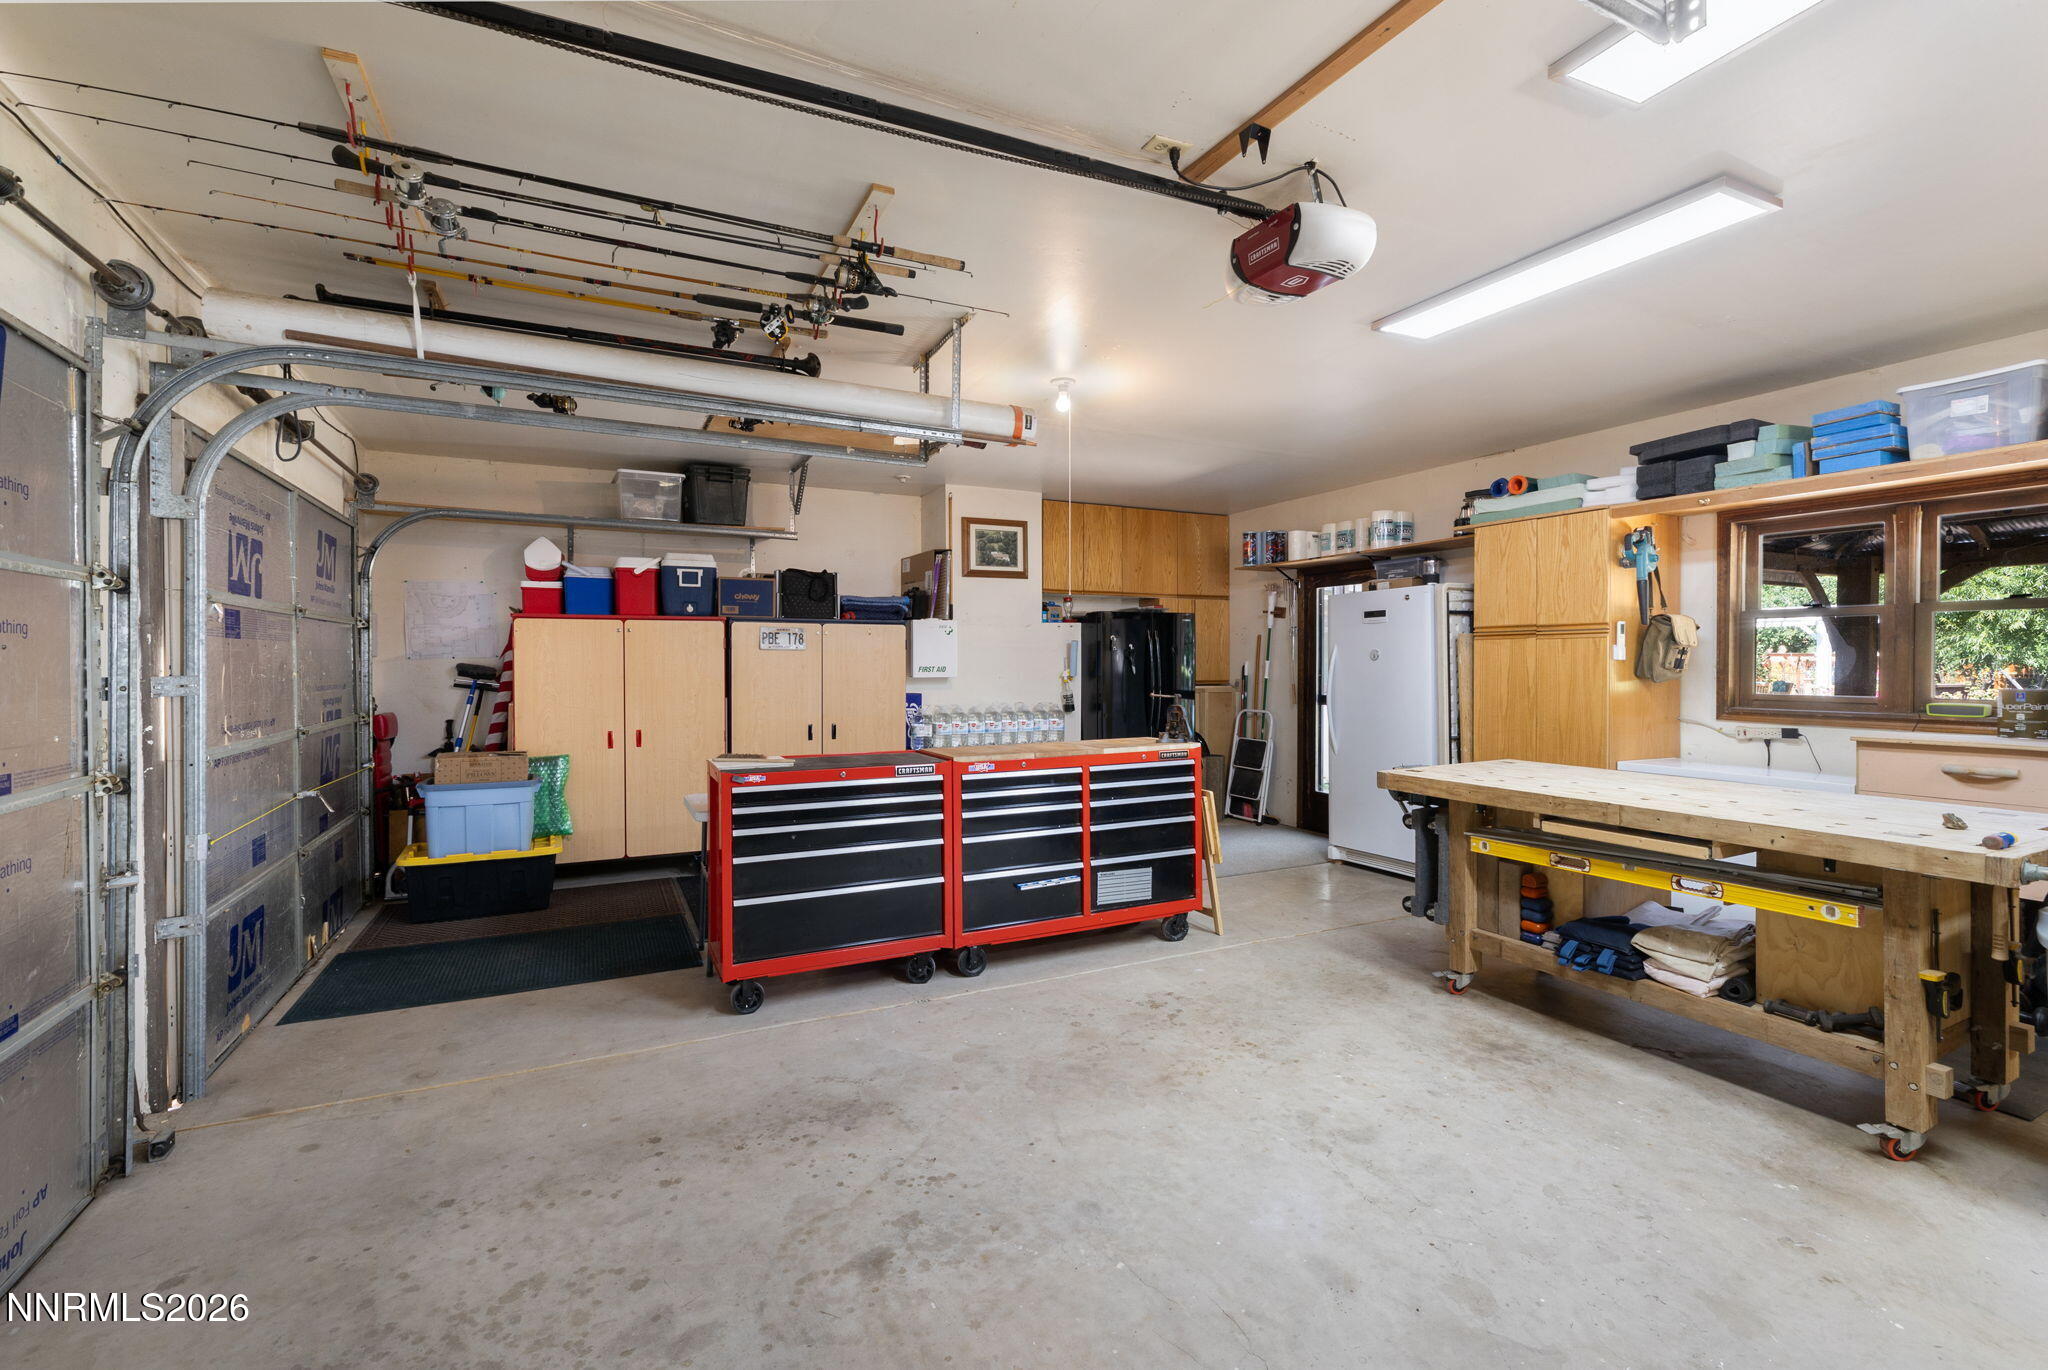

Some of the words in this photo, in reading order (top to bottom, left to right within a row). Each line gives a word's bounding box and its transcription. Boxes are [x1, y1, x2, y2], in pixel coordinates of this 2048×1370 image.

[1250, 240, 1278, 261] CRAFTSMAN
[734, 593, 760, 601] chewy
[0, 619, 28, 640] thing
[762, 631, 780, 645] PBE
[788, 632, 804, 646] 178
[918, 665, 935, 673] FIRST
[936, 665, 947, 673] AID
[2001, 703, 2048, 711] uperPaint
[898, 766, 933, 775] CRAFTSMAN
[32, 1183, 48, 1209] AP
[12, 1200, 30, 1230] Foil
[0, 1230, 27, 1272] Joh
